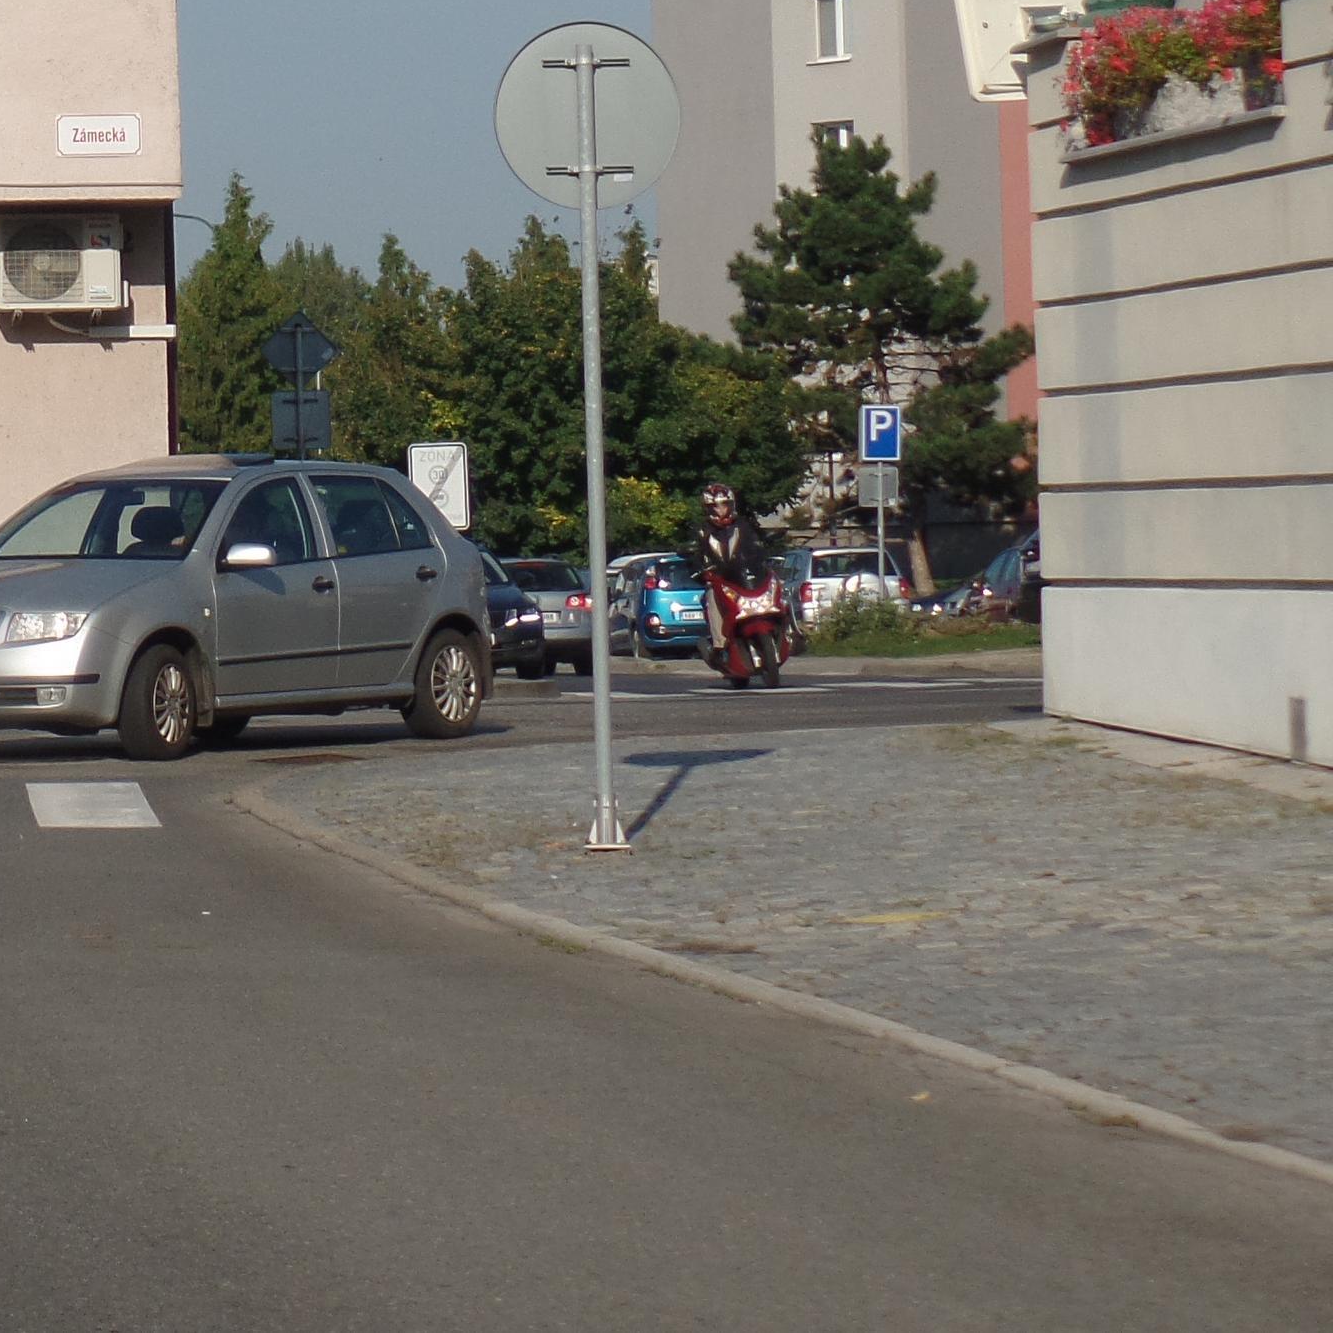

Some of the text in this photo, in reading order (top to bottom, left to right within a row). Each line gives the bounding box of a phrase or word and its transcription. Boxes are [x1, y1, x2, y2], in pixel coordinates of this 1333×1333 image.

[72, 127, 126, 143] Zámecká
[870, 410, 893, 442] P
[419, 449, 460, 462] ZONA
